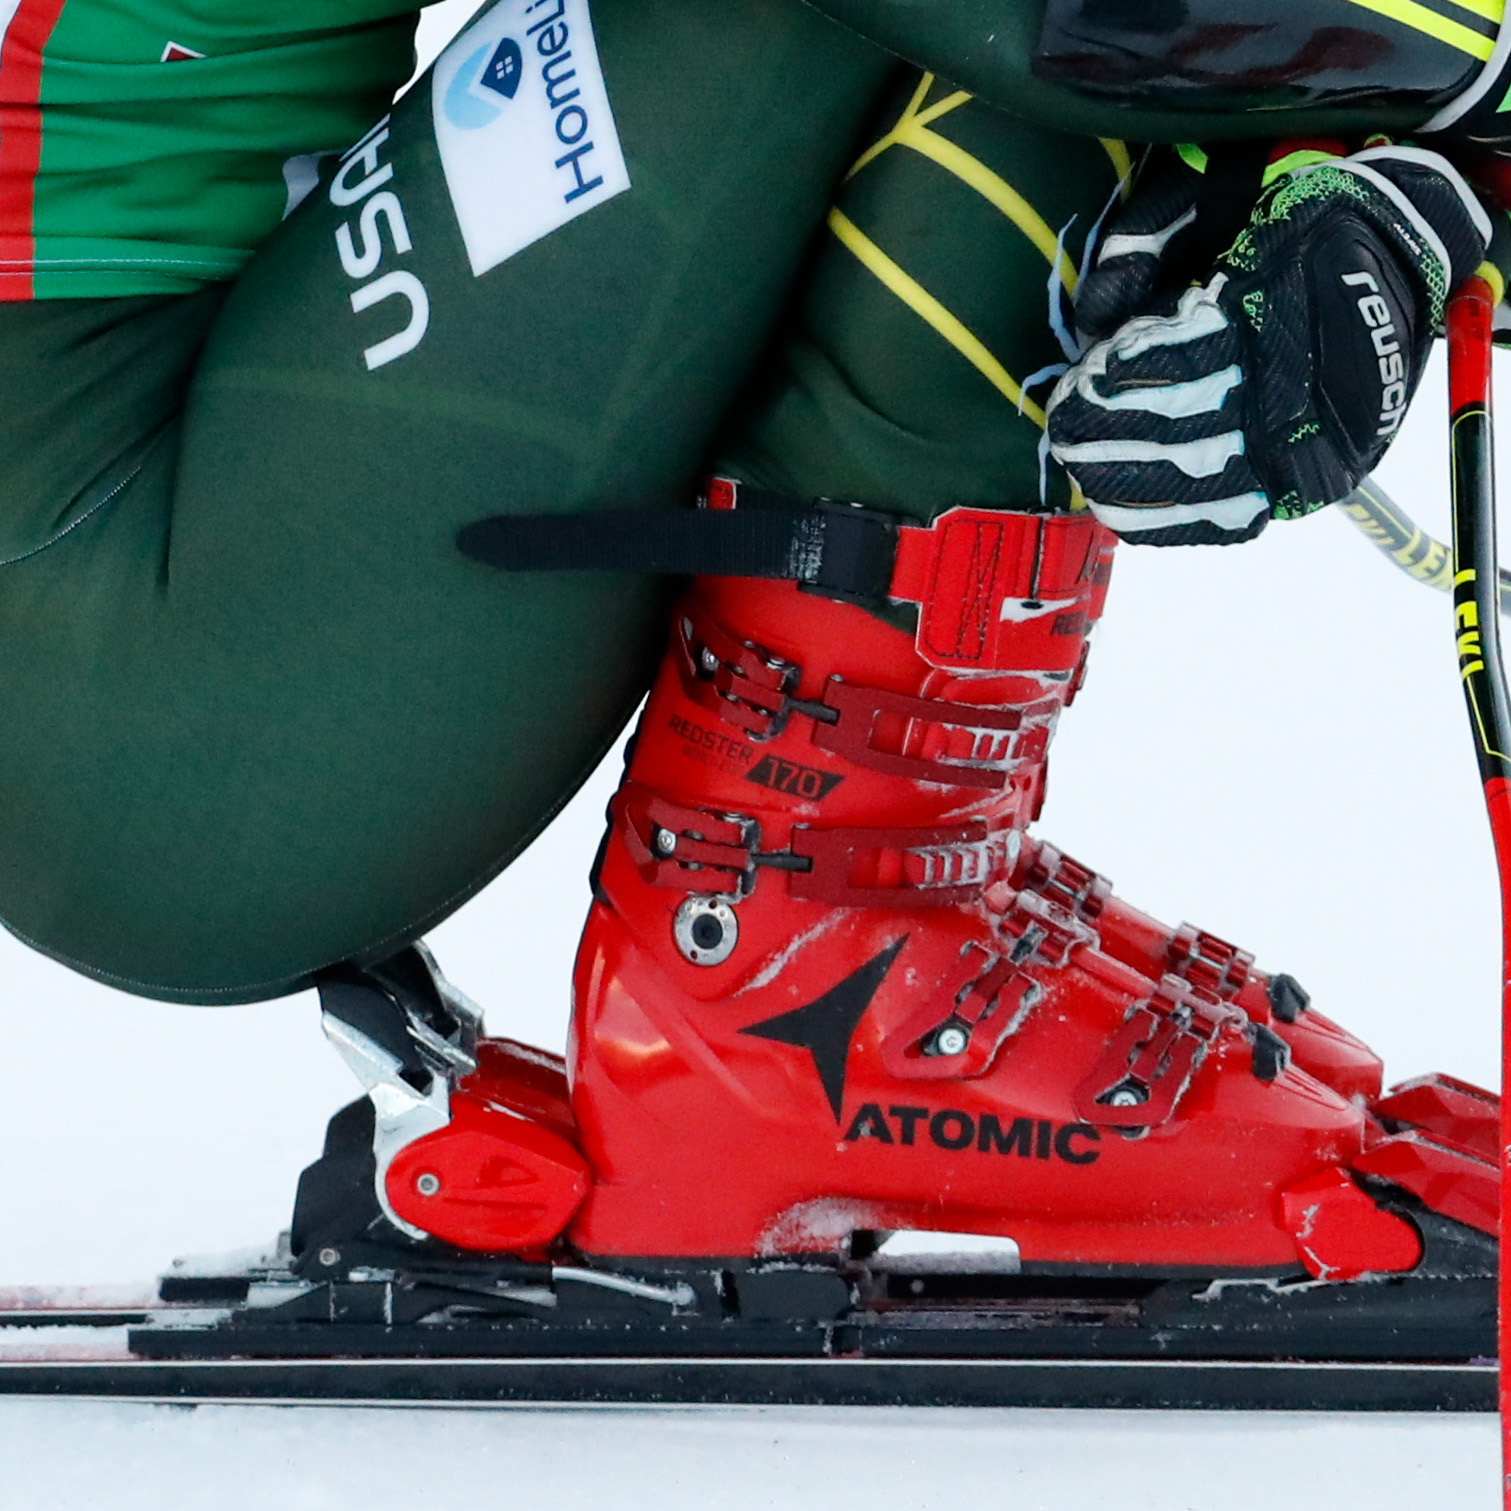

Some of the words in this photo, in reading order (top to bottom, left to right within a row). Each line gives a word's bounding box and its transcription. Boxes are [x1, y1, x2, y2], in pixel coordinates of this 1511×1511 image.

[1341, 270, 1407, 437] reusch
[667, 713, 755, 765] REDSTER
[768, 757, 824, 799] 170
[844, 1102, 1101, 1166] ATOMIC
